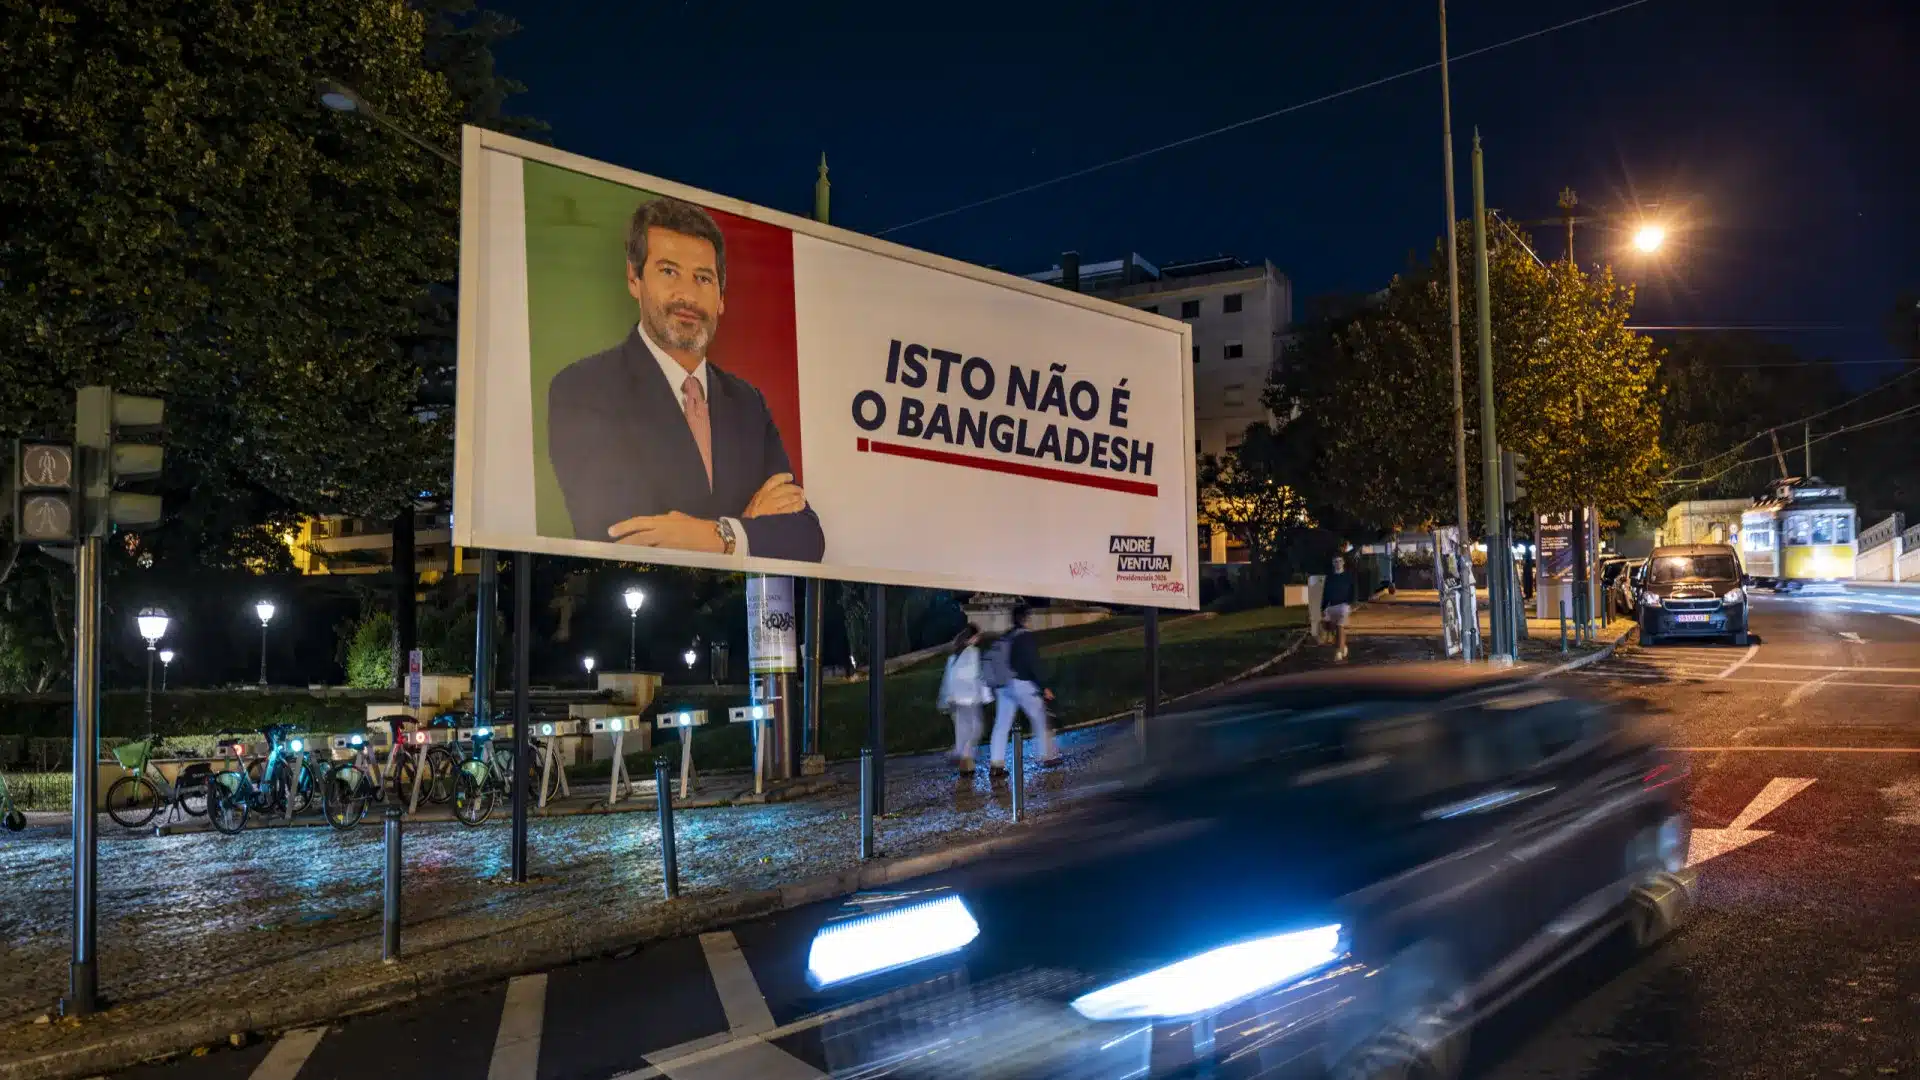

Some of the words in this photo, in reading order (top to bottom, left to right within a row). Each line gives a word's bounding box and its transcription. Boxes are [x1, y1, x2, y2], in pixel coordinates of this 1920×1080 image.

[885, 339, 995, 400] ISTO
[1006, 362, 1100, 421] NÃO
[1109, 377, 1131, 428] É
[851, 389, 887, 431] O
[897, 396, 1154, 476] BANGLADESH
[1540, 523, 1563, 531] Portugal
[1111, 536, 1152, 553] ANDRÉ
[1119, 557, 1170, 571] VENTURA
